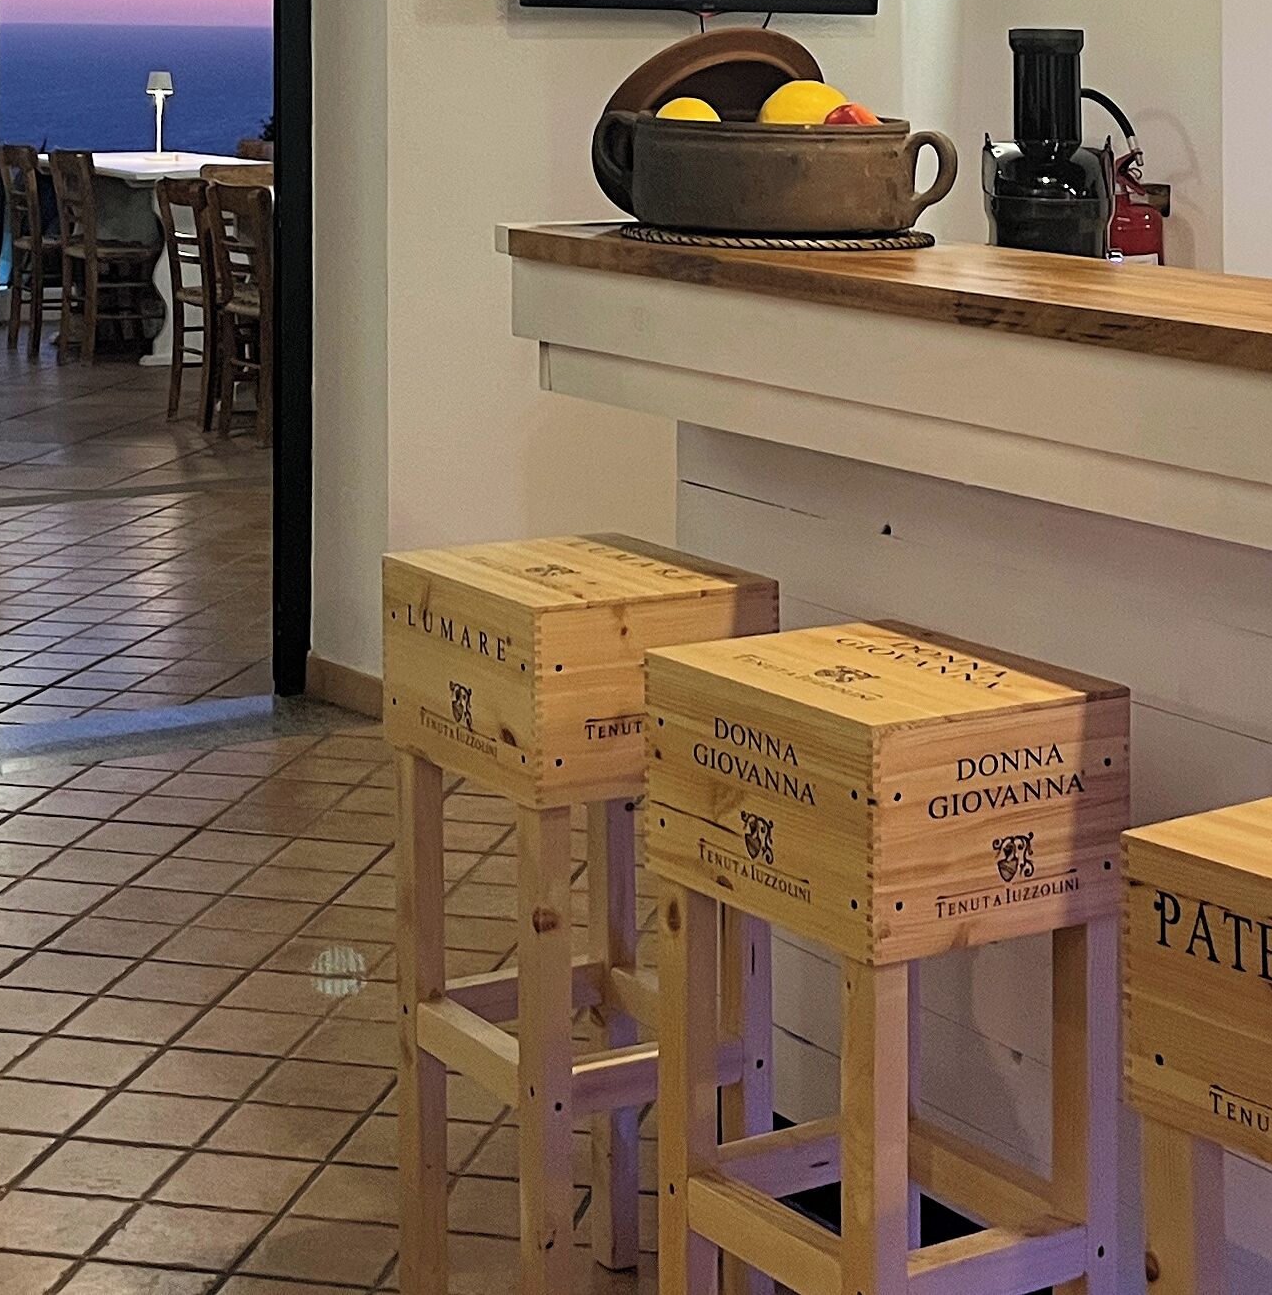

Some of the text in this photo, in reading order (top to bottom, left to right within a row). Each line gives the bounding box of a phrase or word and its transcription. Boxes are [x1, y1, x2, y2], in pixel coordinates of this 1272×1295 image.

[407, 604, 507, 662] LUMARE
[420, 709, 455, 739] TENUTA
[585, 720, 642, 740] TENUT
[714, 717, 799, 767] DONNA
[693, 743, 816, 806] GIOVANNA
[957, 742, 1064, 782] DONNA
[928, 772, 1086, 820] GIOVANNA
[698, 842, 812, 904] TENUTA IUZZOLINI
[935, 877, 1080, 919] TENUTA IUZZOLINI
